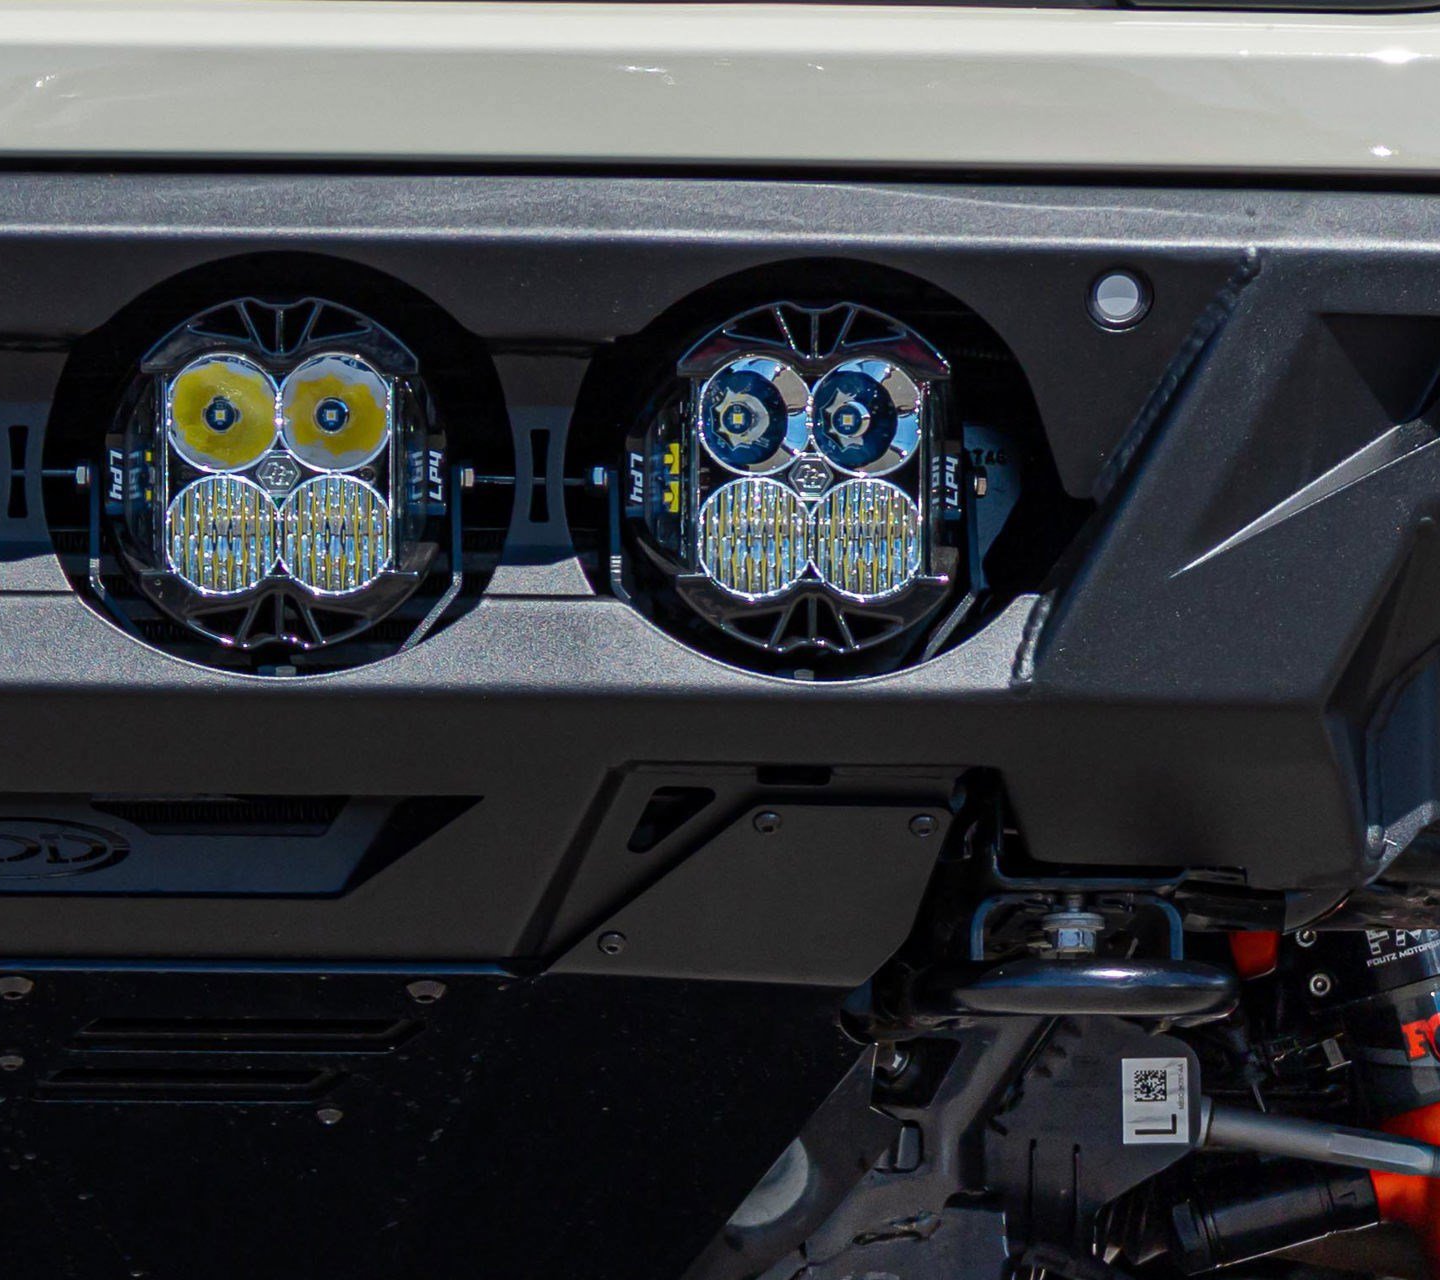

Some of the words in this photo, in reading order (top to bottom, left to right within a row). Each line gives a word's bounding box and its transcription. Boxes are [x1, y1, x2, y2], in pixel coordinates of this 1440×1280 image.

[108, 449, 124, 501] LP4
[428, 449, 445, 502] LP4
[628, 451, 645, 504] LP4
[944, 455, 960, 509] LP4
[1366, 952, 1398, 968] FOUTZ
[1134, 1113, 1178, 1136] L
